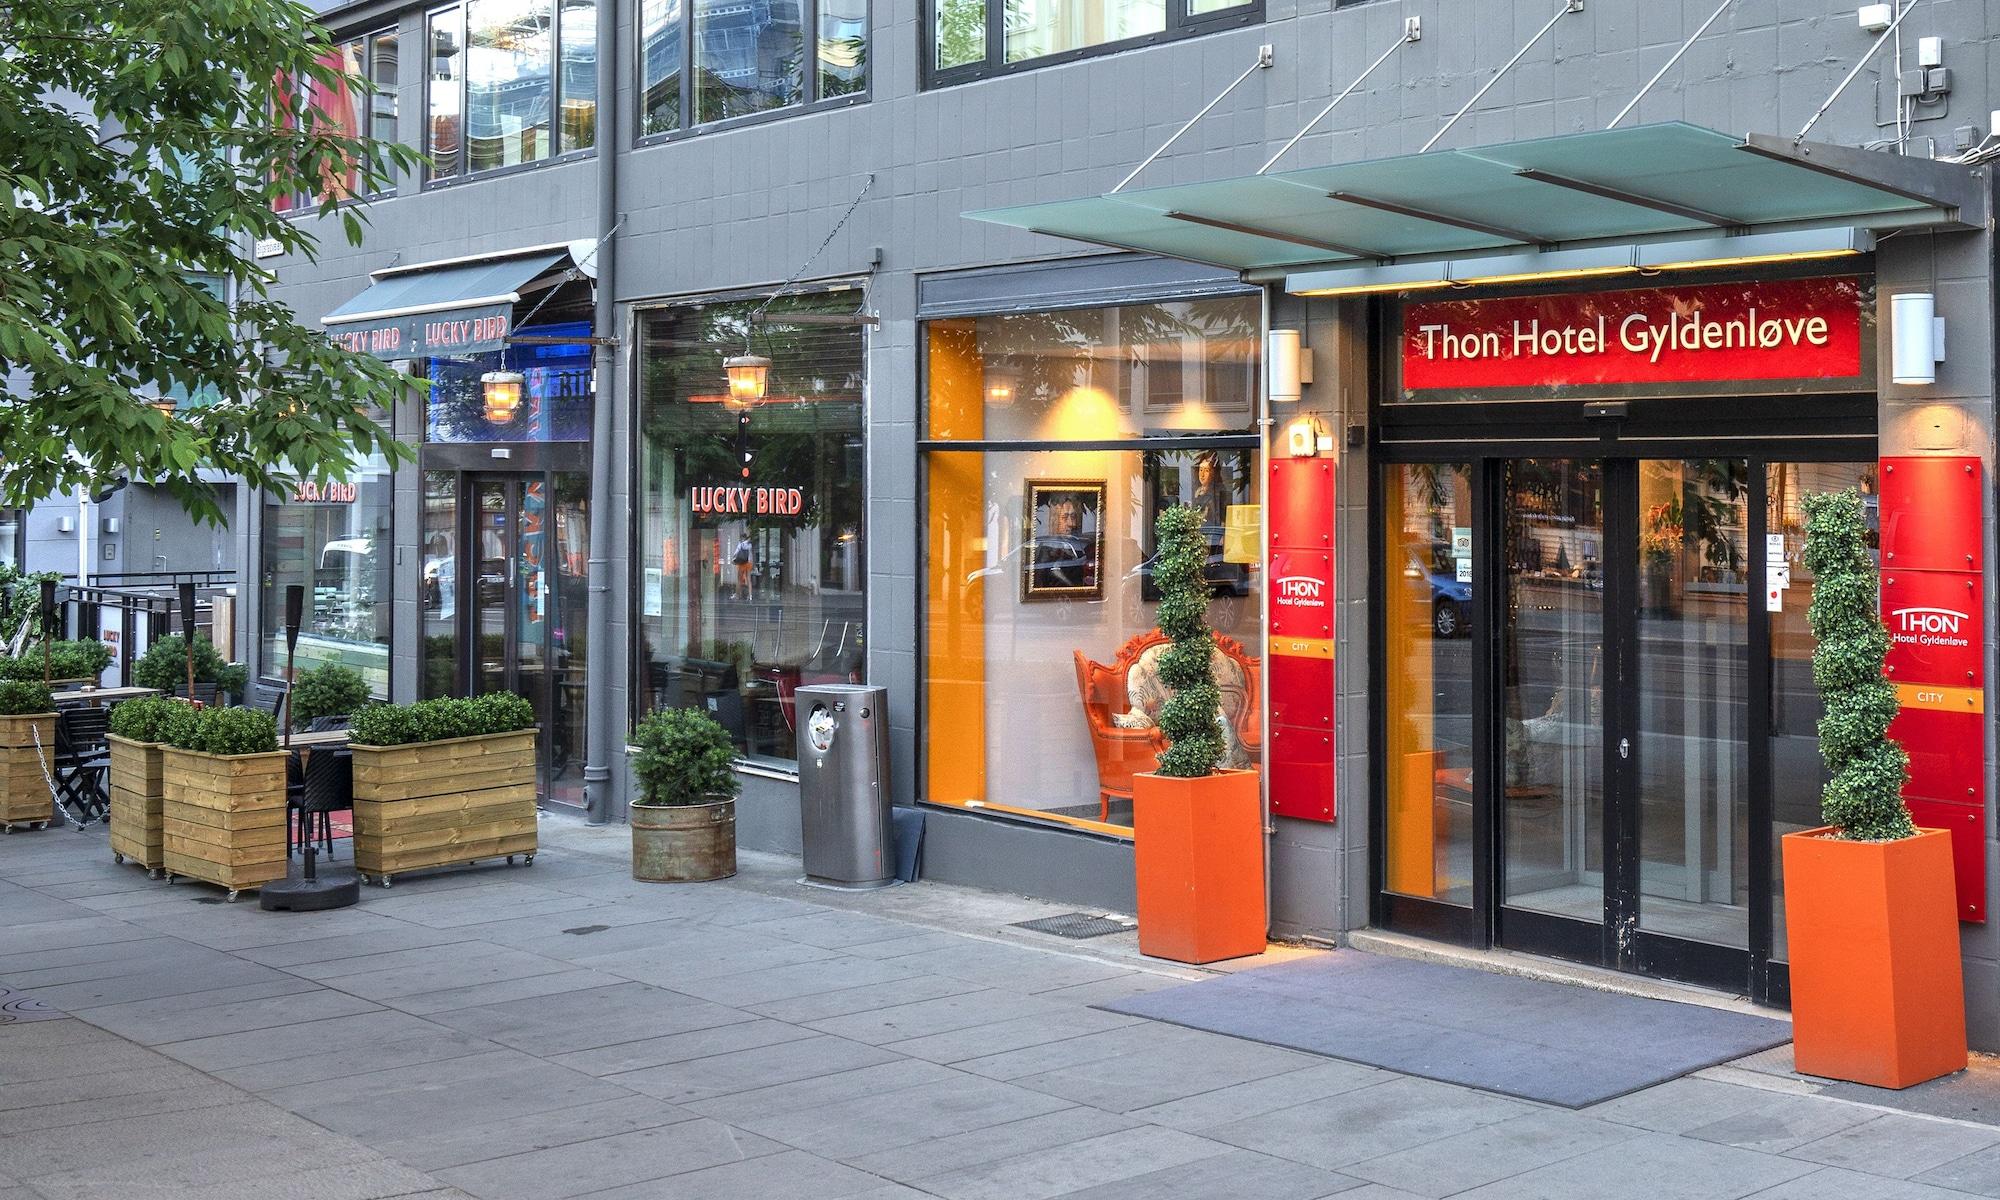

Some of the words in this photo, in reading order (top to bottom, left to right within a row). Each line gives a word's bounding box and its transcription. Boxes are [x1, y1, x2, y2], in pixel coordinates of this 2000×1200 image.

[372, 327, 400, 352] BIRD
[426, 319, 470, 346] LUCKY
[474, 315, 507, 342] BIRD
[1419, 324, 1499, 360] Thon
[1513, 316, 1605, 356] Hotel
[1619, 308, 1828, 363] Gyldenløve
[330, 482, 356, 503] BIRD
[692, 486, 752, 513] LUCKY
[756, 487, 803, 515] BIRD
[1276, 576, 1325, 597] THON
[1892, 608, 1969, 634] THON
[1292, 643, 1309, 652] CITY
[1893, 633, 1917, 643] Hotel
[1920, 635, 1968, 647] Gyldenløve
[1917, 692, 1944, 703] CITY
